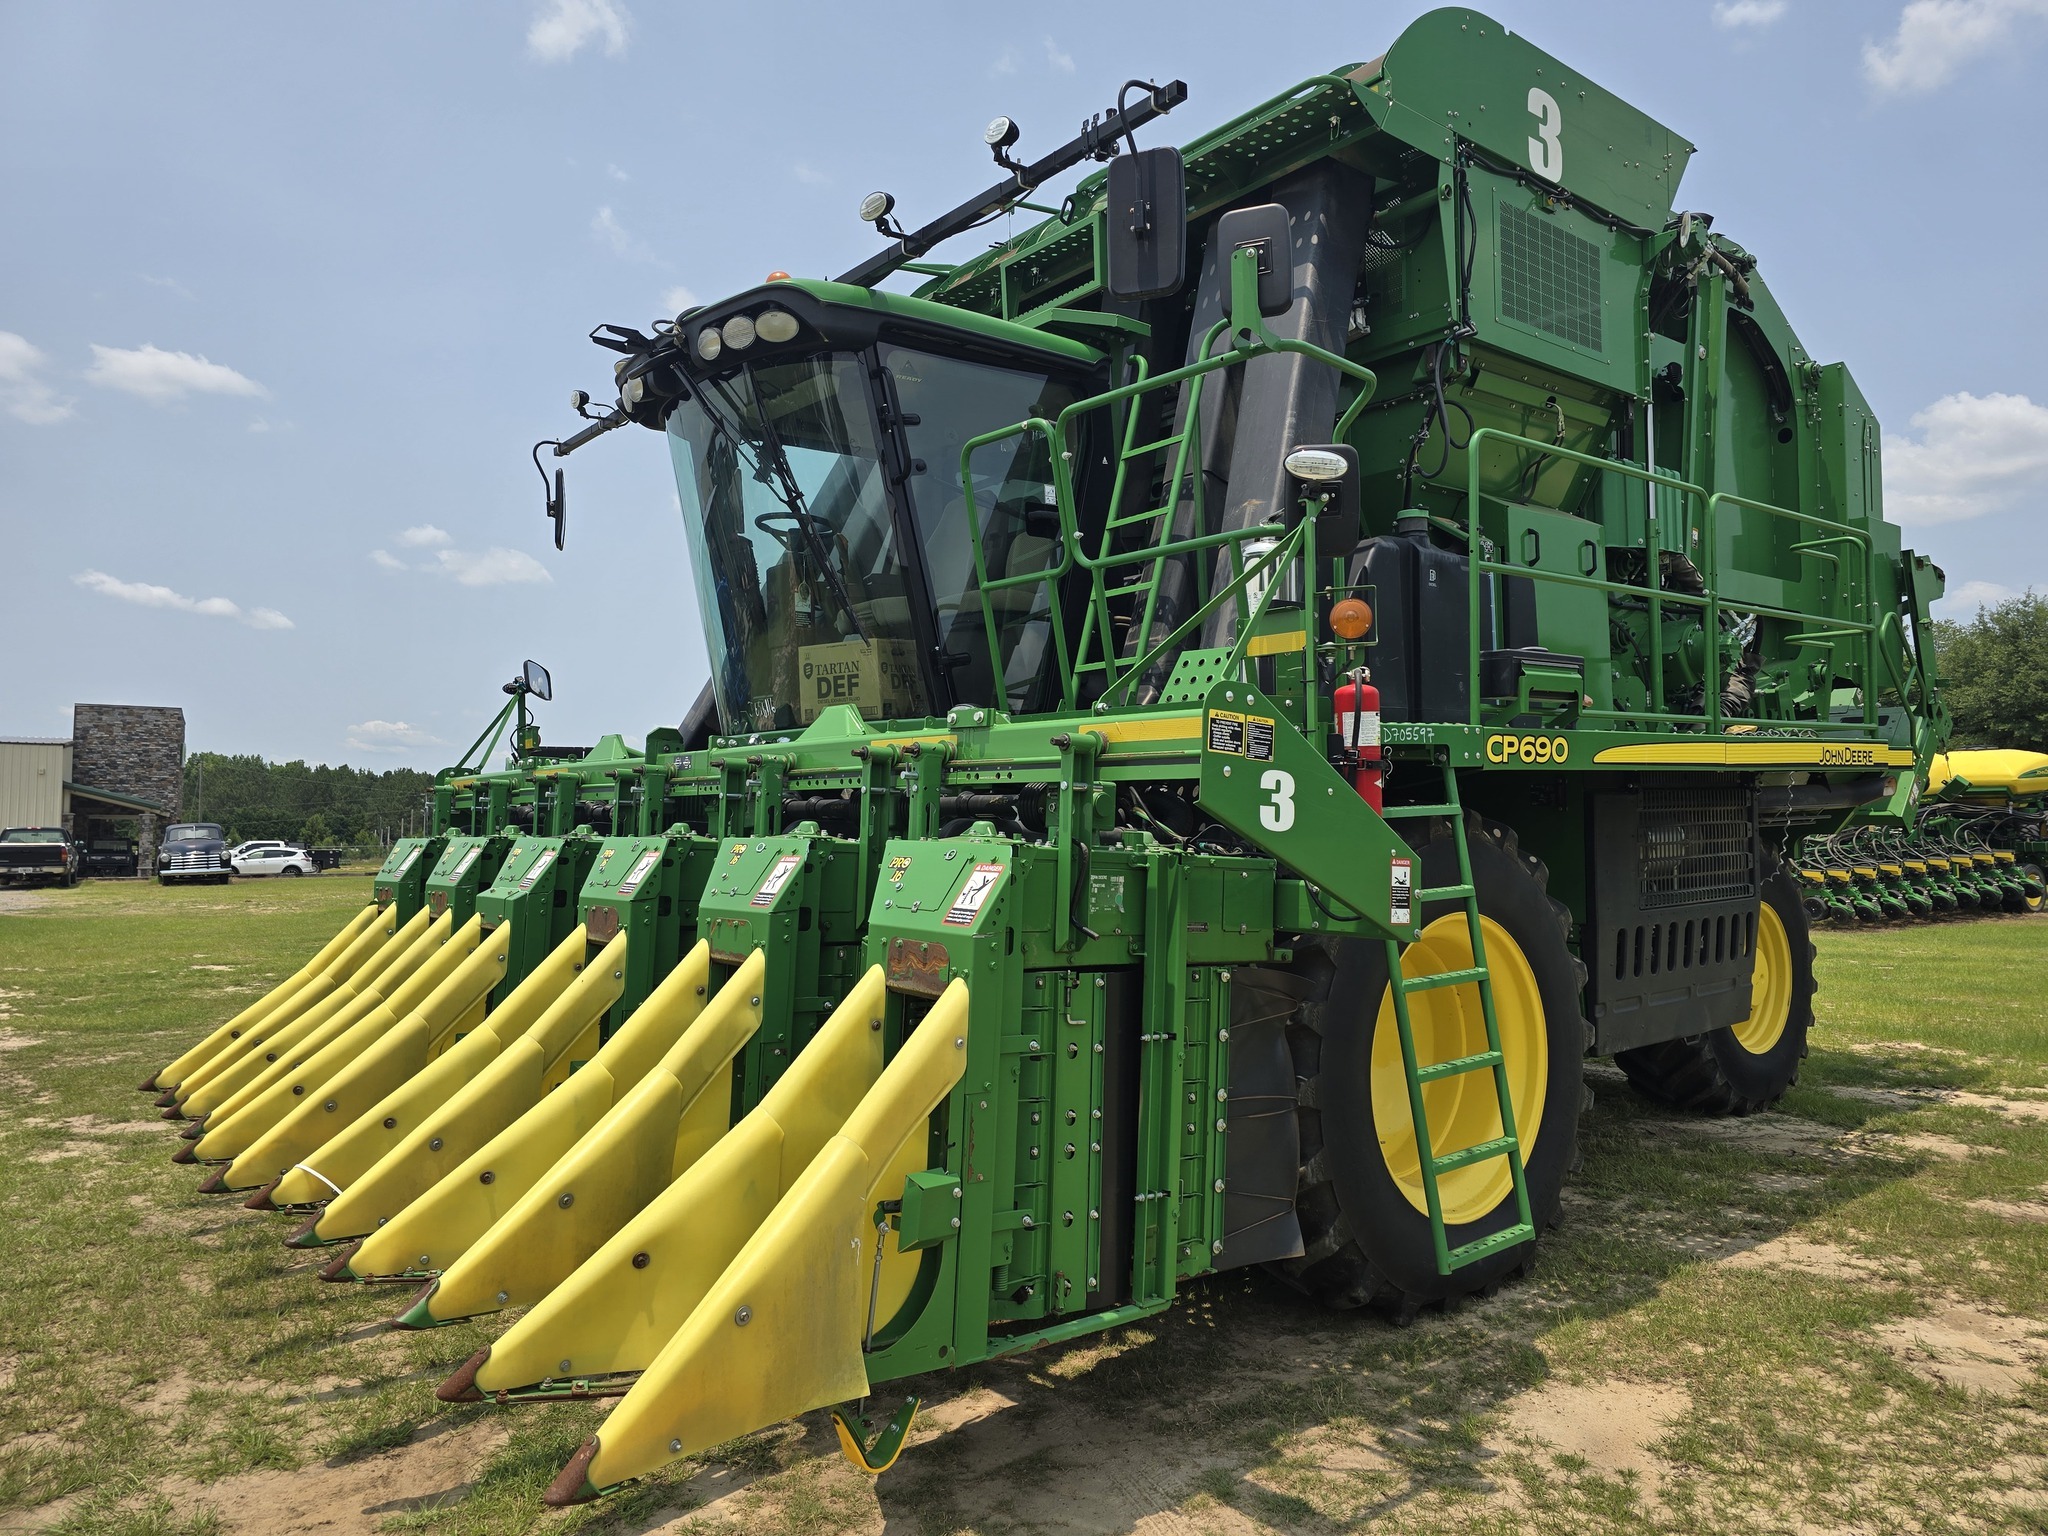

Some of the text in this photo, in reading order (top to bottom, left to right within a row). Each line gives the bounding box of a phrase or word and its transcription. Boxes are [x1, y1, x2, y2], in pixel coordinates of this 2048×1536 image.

[1528, 87, 1563, 184] 3
[895, 374, 923, 383] READY
[815, 661, 860, 676] TARTAN
[817, 674, 860, 699] DEF
[1220, 711, 1240, 721] CAUTION
[1384, 727, 1435, 743] D705597
[1486, 734, 1569, 764] CP690
[1819, 746, 1874, 765] JOHN DEERE
[1259, 769, 1296, 832] 3
[888, 857, 912, 868] PRO
[980, 864, 1003, 872] DANGER
[889, 870, 905, 882] 16
